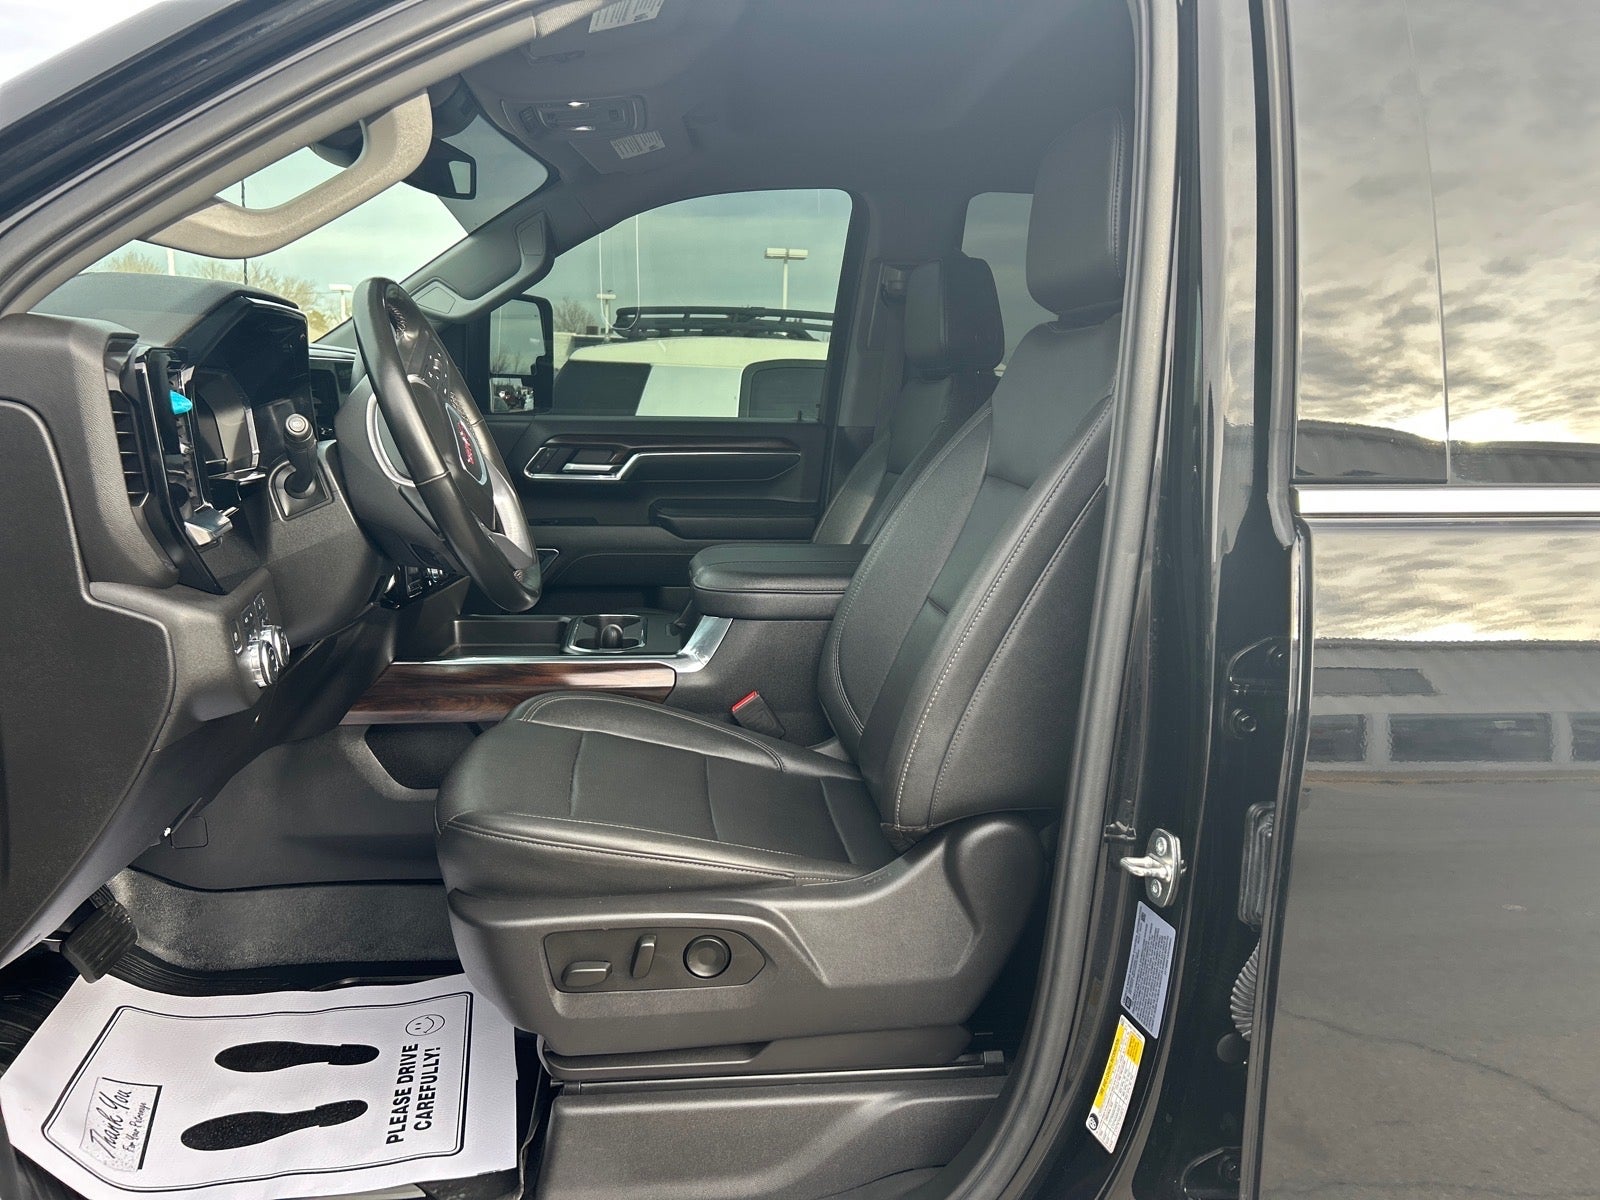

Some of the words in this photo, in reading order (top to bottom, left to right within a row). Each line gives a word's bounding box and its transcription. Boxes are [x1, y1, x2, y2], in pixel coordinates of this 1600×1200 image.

[396, 1043, 419, 1085] DRIVE
[98, 1089, 132, 1111] You
[413, 1047, 441, 1131] CAREFULLY!
[90, 1107, 124, 1159] Thank
[125, 1128, 140, 1141] Your
[385, 1087, 412, 1145] PLEASE
[122, 1142, 136, 1153] For
